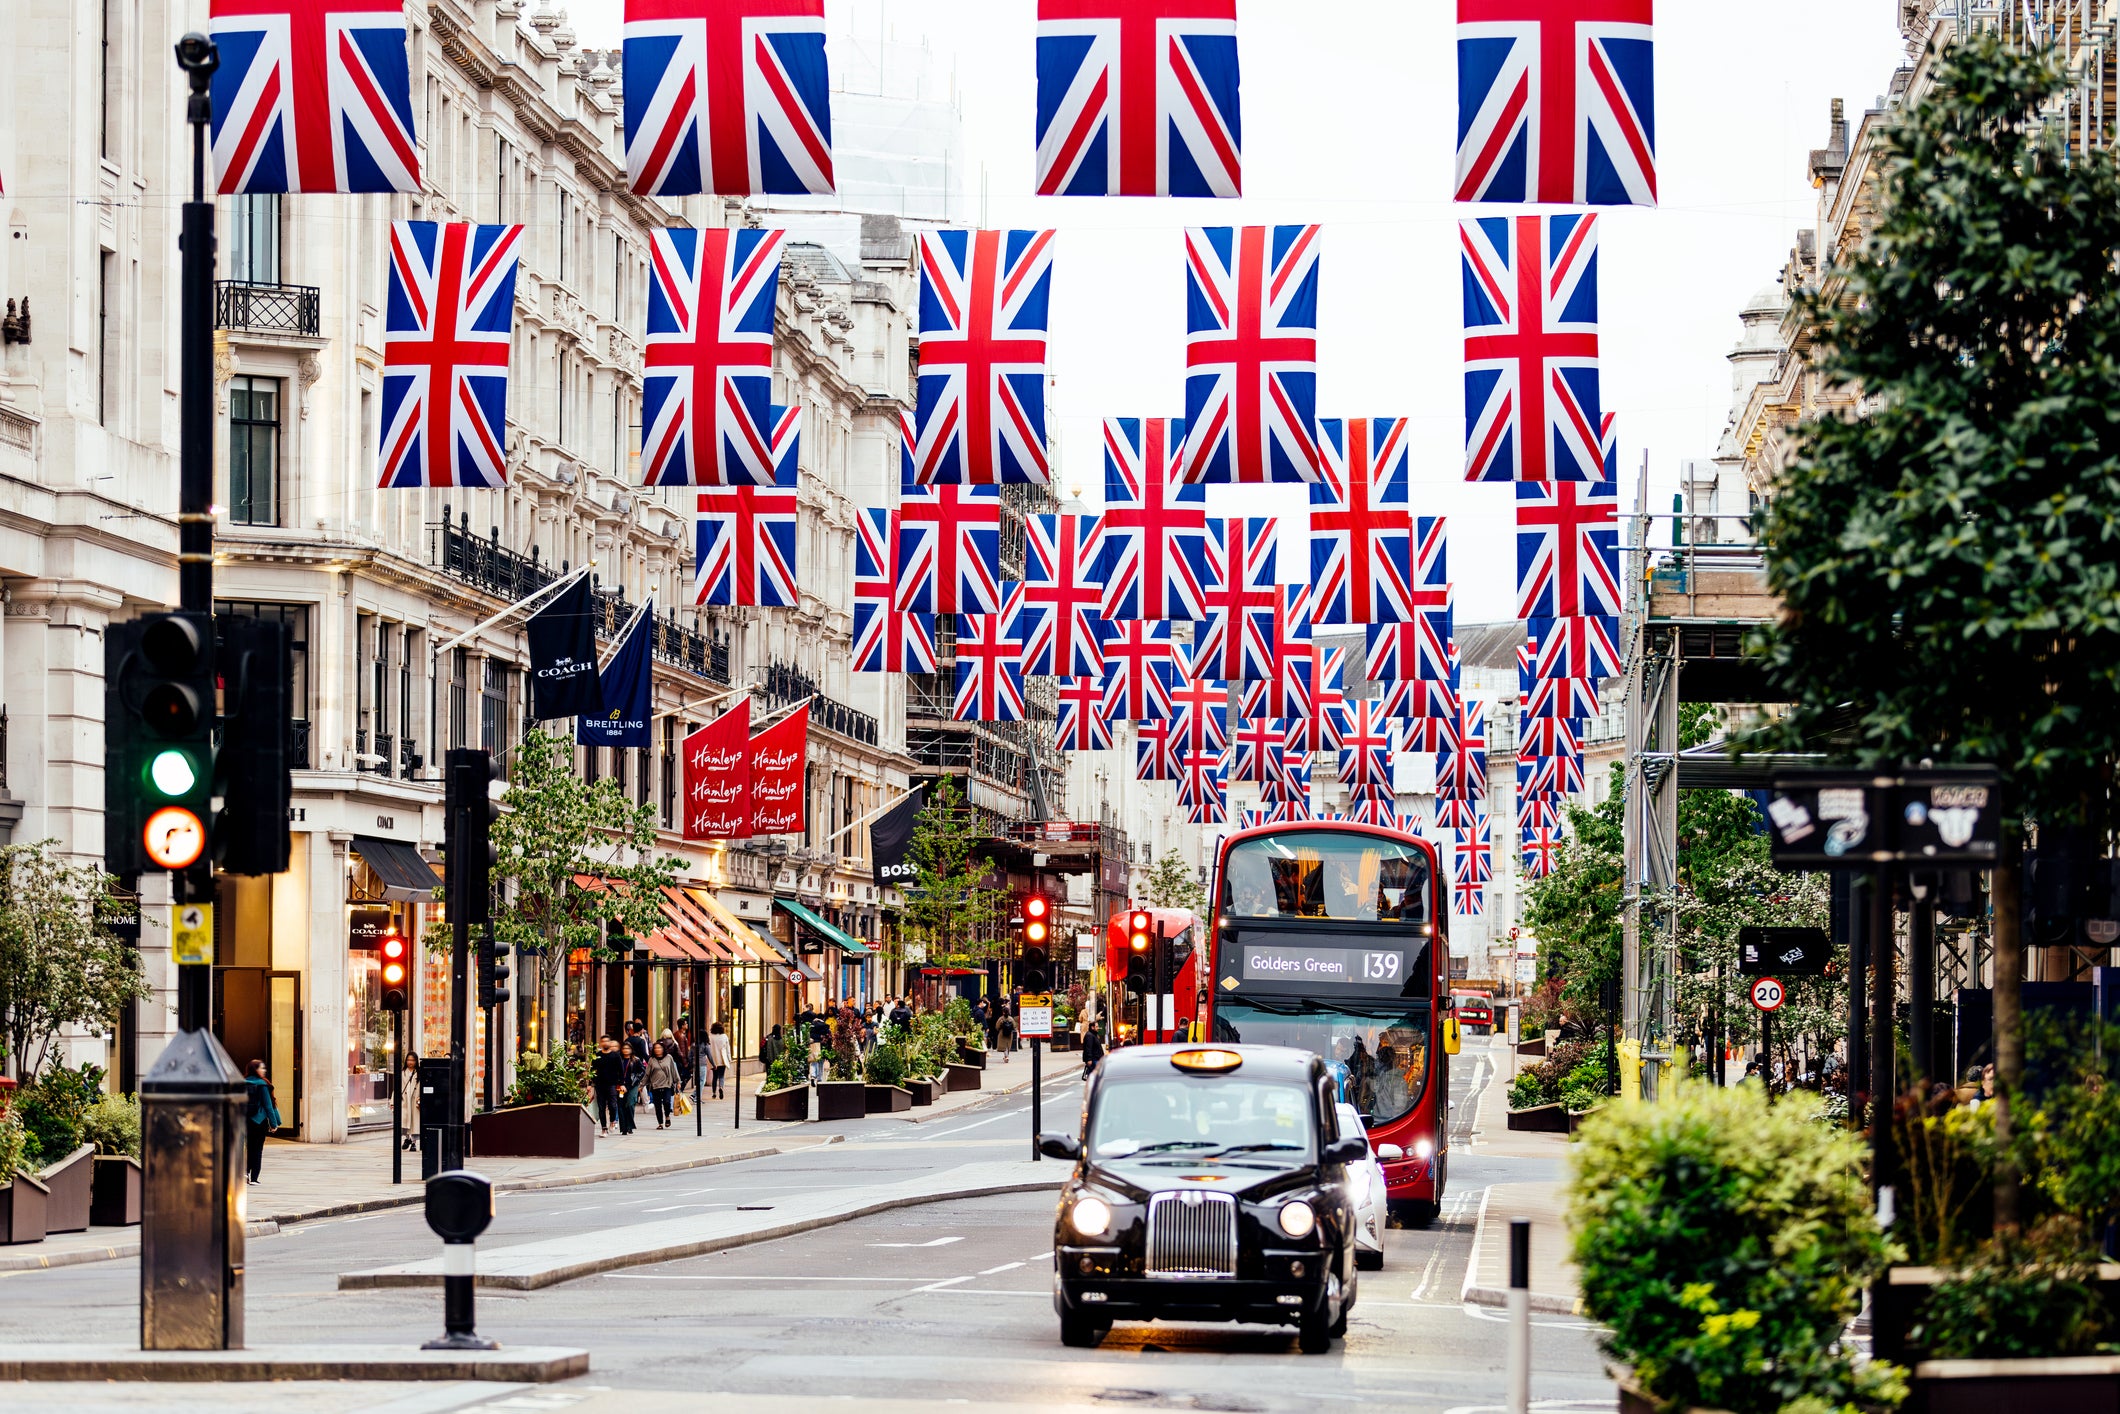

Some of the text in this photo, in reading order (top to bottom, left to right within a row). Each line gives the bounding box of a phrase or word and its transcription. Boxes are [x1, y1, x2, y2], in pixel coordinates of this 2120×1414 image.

[537, 661, 593, 678] COACH
[585, 719, 644, 729] BREITLING
[691, 743, 743, 772] Hamleys
[751, 747, 798, 771] Hamleys
[691, 776, 743, 804] Hamleys
[751, 776, 797, 801] Hamleys
[376, 815, 394, 830] COACH
[691, 809, 743, 836] Hamleys
[751, 806, 797, 830] Hamleys
[881, 863, 918, 878] BOSS
[110, 916, 138, 925] HOME
[352, 928, 389, 936] COACH
[1251, 953, 1399, 979] Golders Green 139
[791, 973, 802, 981] 20
[1757, 987, 1780, 1001] 20
[1186, 1052, 1228, 1064] TAI
